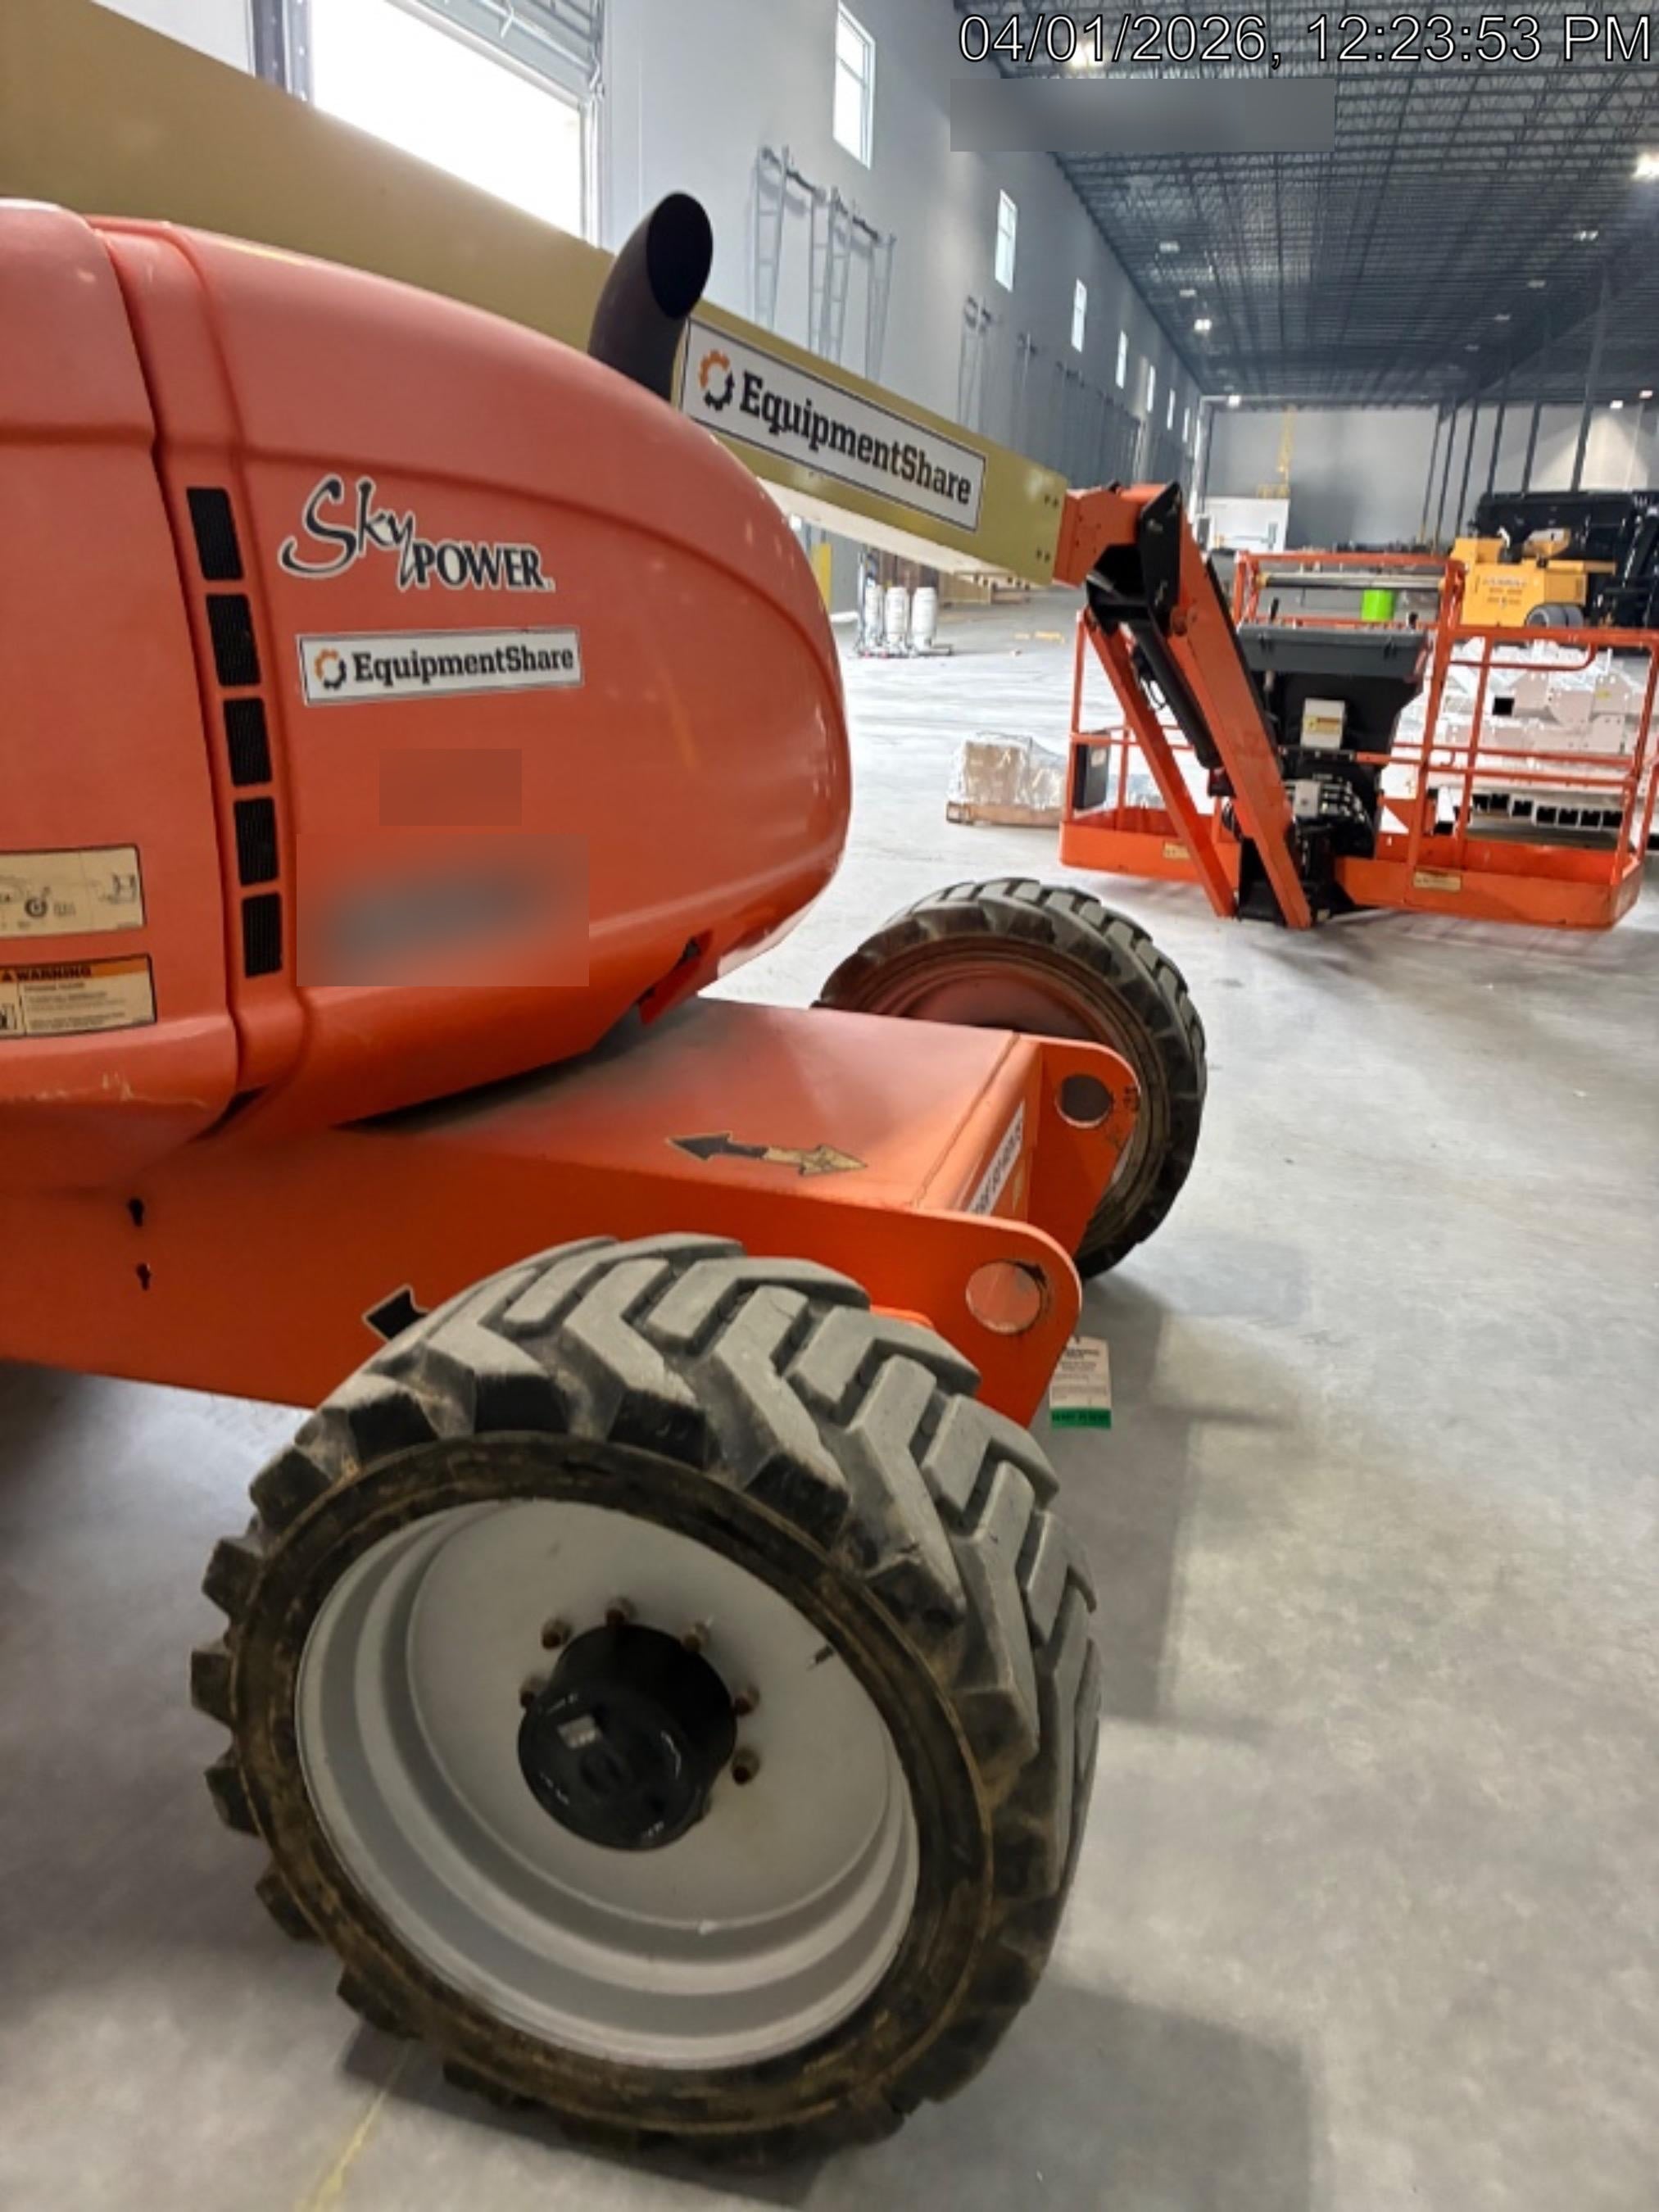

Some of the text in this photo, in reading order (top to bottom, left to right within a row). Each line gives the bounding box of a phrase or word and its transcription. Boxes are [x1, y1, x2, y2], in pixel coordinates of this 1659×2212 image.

[740, 370, 972, 505] EquipmentShare
[351, 646, 574, 688] EquipmentShare
[16, 965, 92, 981] WARNING
